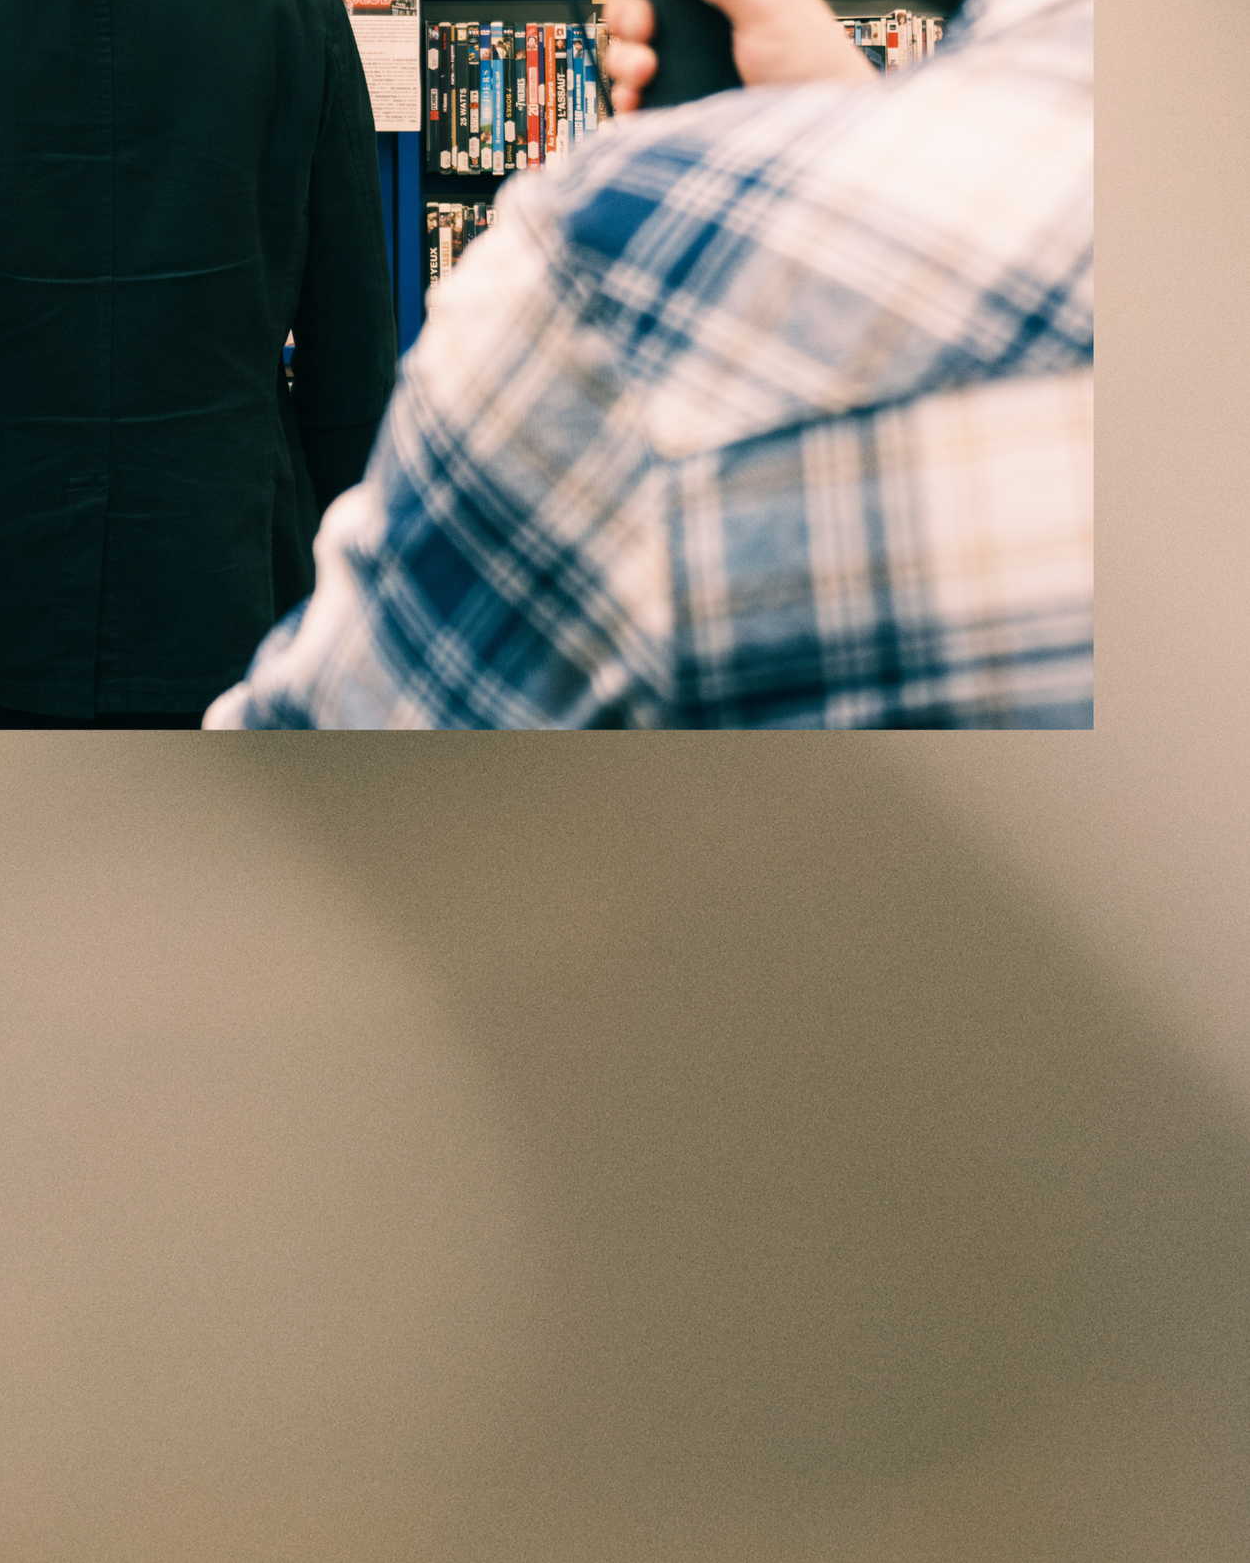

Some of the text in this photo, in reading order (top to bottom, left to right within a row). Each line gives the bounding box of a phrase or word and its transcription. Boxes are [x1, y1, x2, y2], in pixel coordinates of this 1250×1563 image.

[430, 89, 439, 110] FEMMES
[516, 78, 525, 102] VIERGES
[547, 82, 555, 106] Regard
[557, 73, 566, 116] L'ASSAUT
[529, 104, 538, 116] 20
[547, 109, 555, 135] Premier
[430, 247, 438, 274] YEUX
